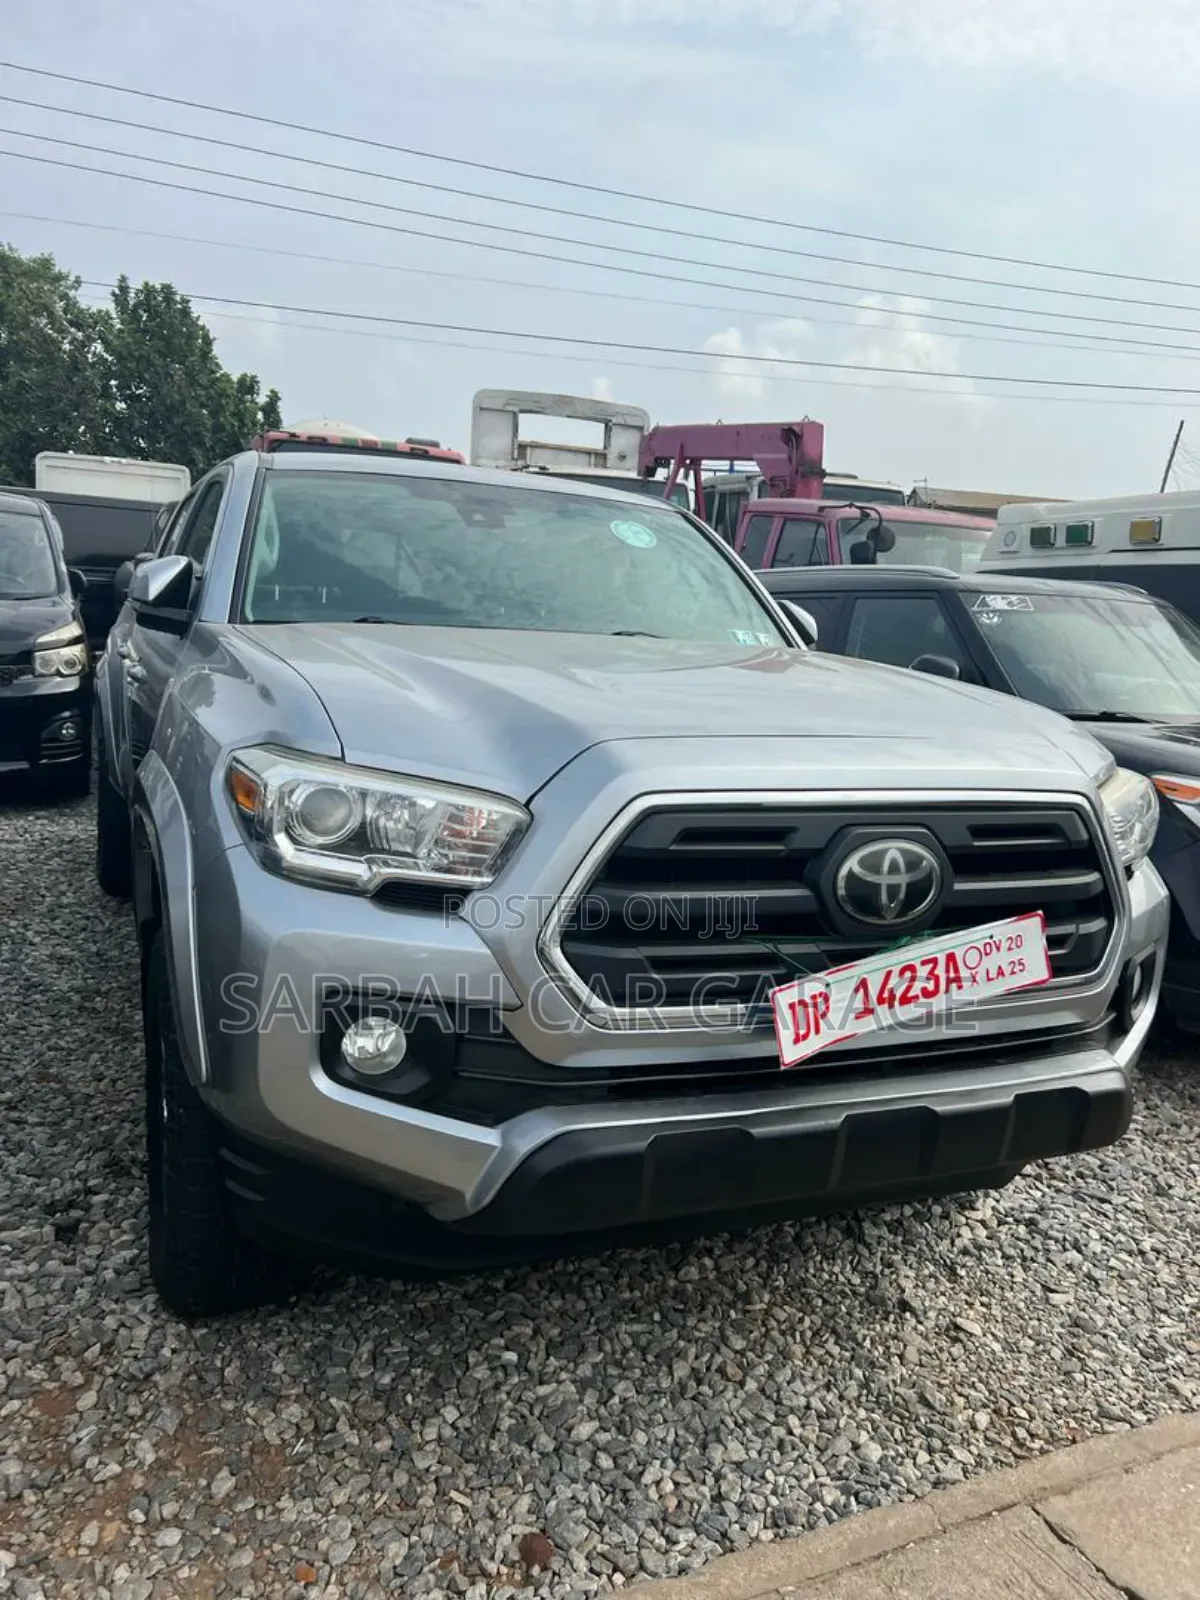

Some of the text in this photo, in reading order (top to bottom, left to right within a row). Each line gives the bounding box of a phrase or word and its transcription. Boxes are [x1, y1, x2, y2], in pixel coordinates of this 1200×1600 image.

[983, 934, 1023, 957] DV 20
[986, 964, 1006, 982] LA
[1008, 958, 1026, 976] 25
[788, 951, 963, 1045] DP 1423A
